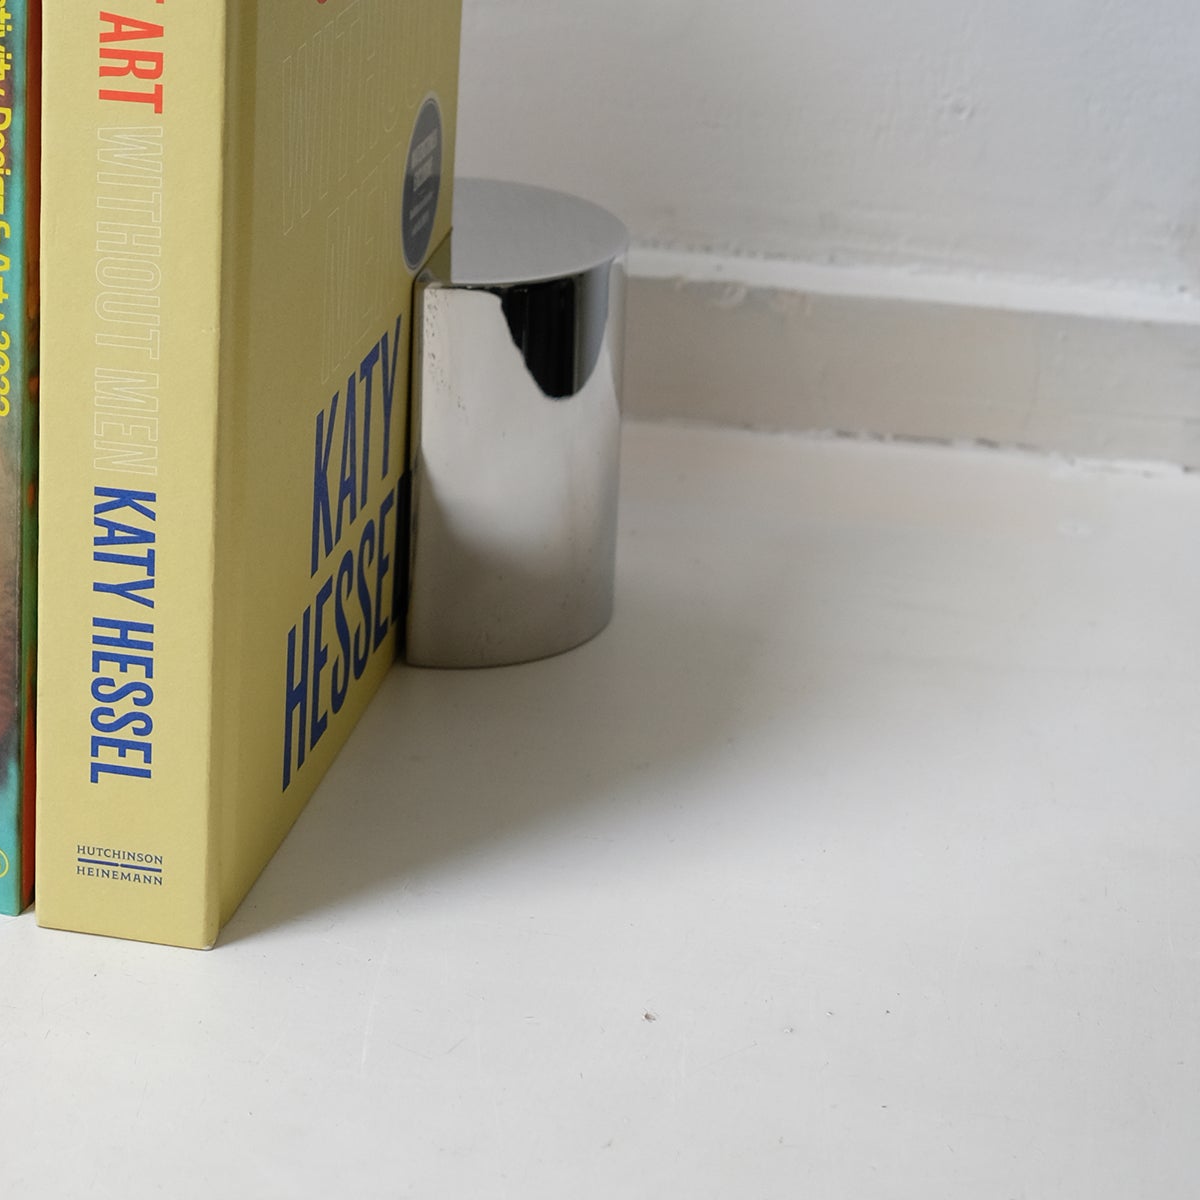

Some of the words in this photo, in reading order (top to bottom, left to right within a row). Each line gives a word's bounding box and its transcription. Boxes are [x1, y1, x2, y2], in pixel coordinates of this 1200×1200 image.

[98, 11, 165, 114] ART
[94, 126, 163, 360] WITHOUT
[93, 367, 159, 475] MEN
[311, 315, 402, 579] KATY
[92, 486, 157, 609] KATY
[90, 616, 155, 785] HESSEL
[76, 865, 163, 886] HEINEMANN
[77, 844, 163, 865] HUTCHINSON
